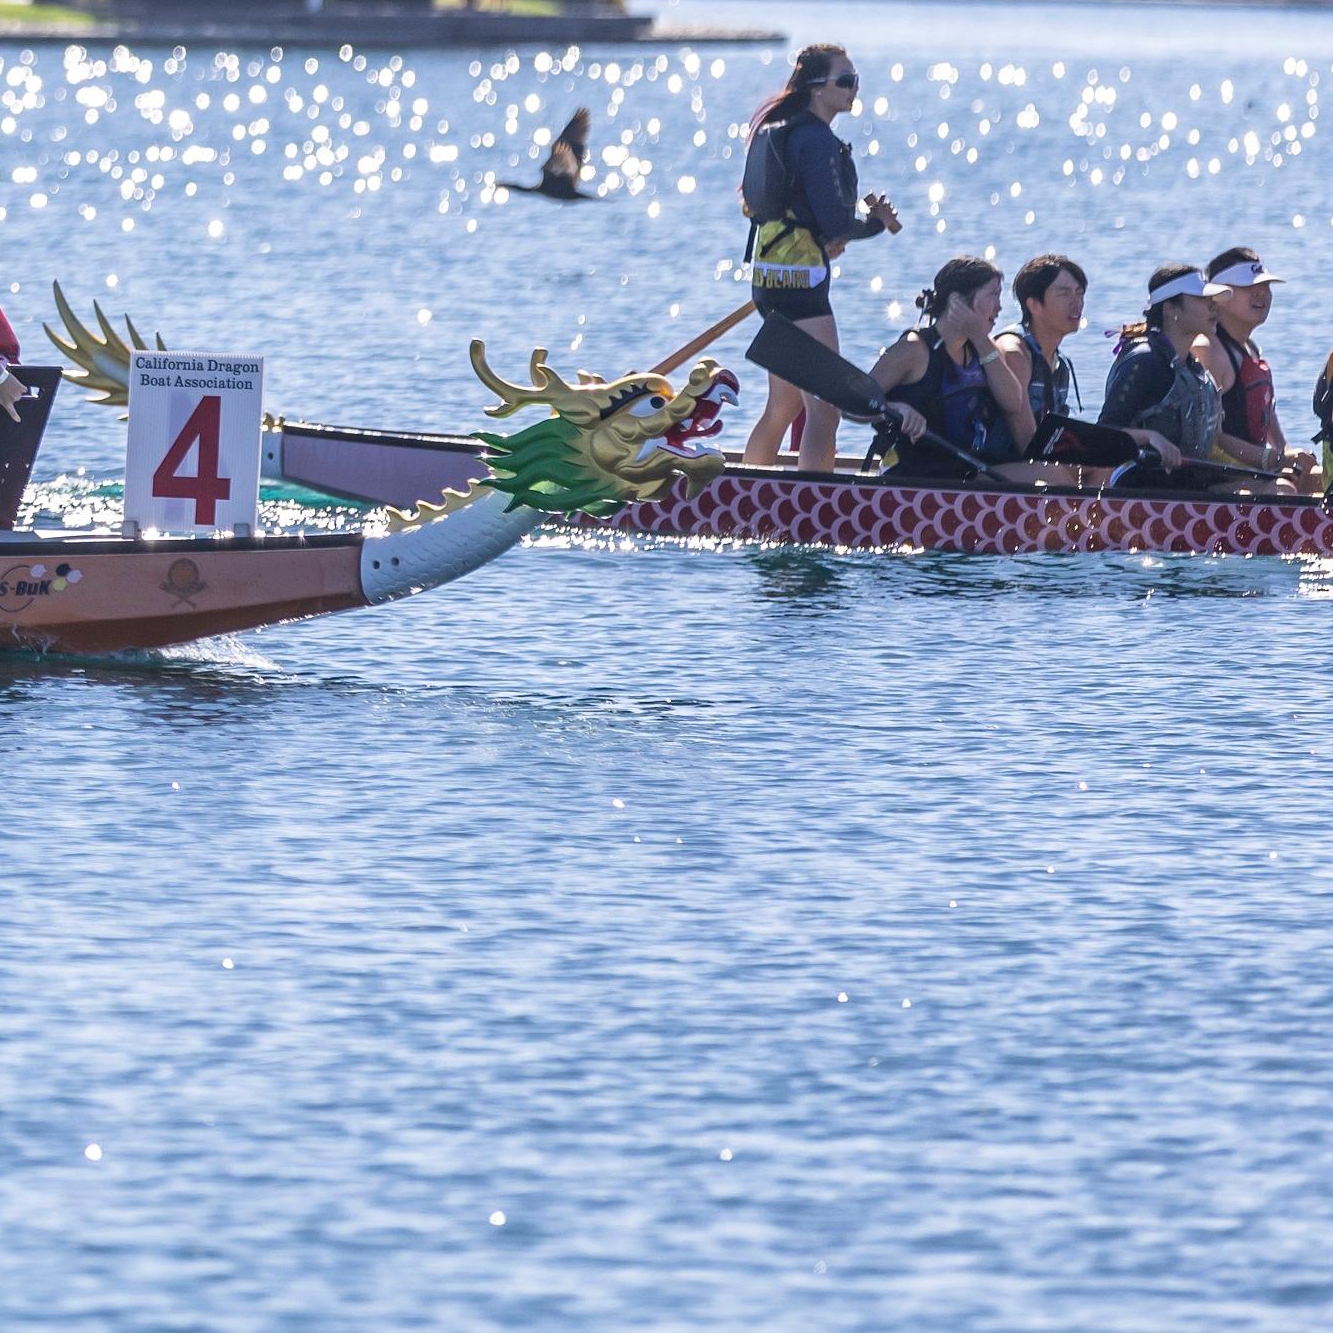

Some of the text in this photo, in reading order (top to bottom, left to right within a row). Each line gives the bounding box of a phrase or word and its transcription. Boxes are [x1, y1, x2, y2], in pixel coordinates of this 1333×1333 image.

[136, 357, 260, 375] California Dragon
[140, 374, 254, 390] Boat Association
[152, 395, 231, 525] 4
